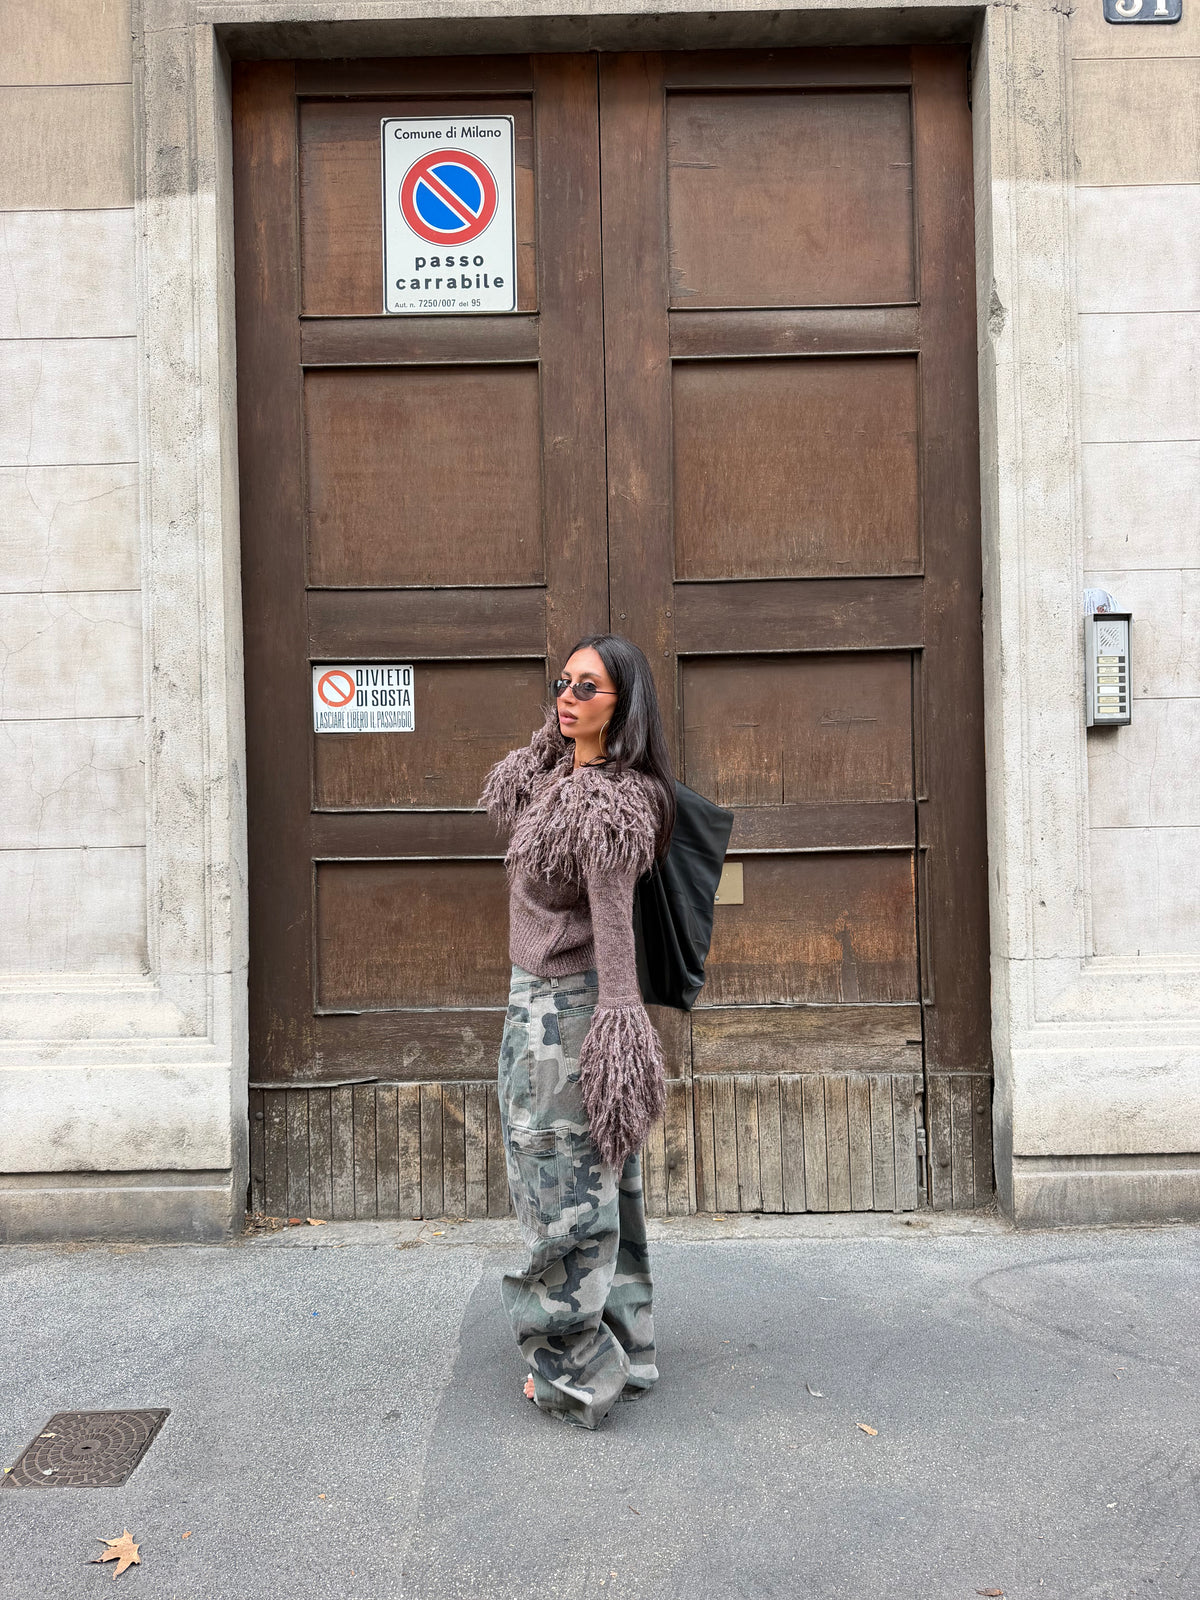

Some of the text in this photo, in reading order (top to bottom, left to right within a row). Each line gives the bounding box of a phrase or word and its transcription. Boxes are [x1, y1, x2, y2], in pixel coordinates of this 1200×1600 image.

[394, 125, 502, 140] Comune di Milano
[415, 255, 484, 271] passo
[396, 273, 504, 290] carrabile
[418, 299, 456, 307] 7250/007
[471, 299, 481, 307] 95
[356, 668, 411, 687] DIVIETO
[356, 689, 411, 707] DI SOSTA
[315, 710, 412, 729] LASCIARE LIBERO IL PASSAGGIO
